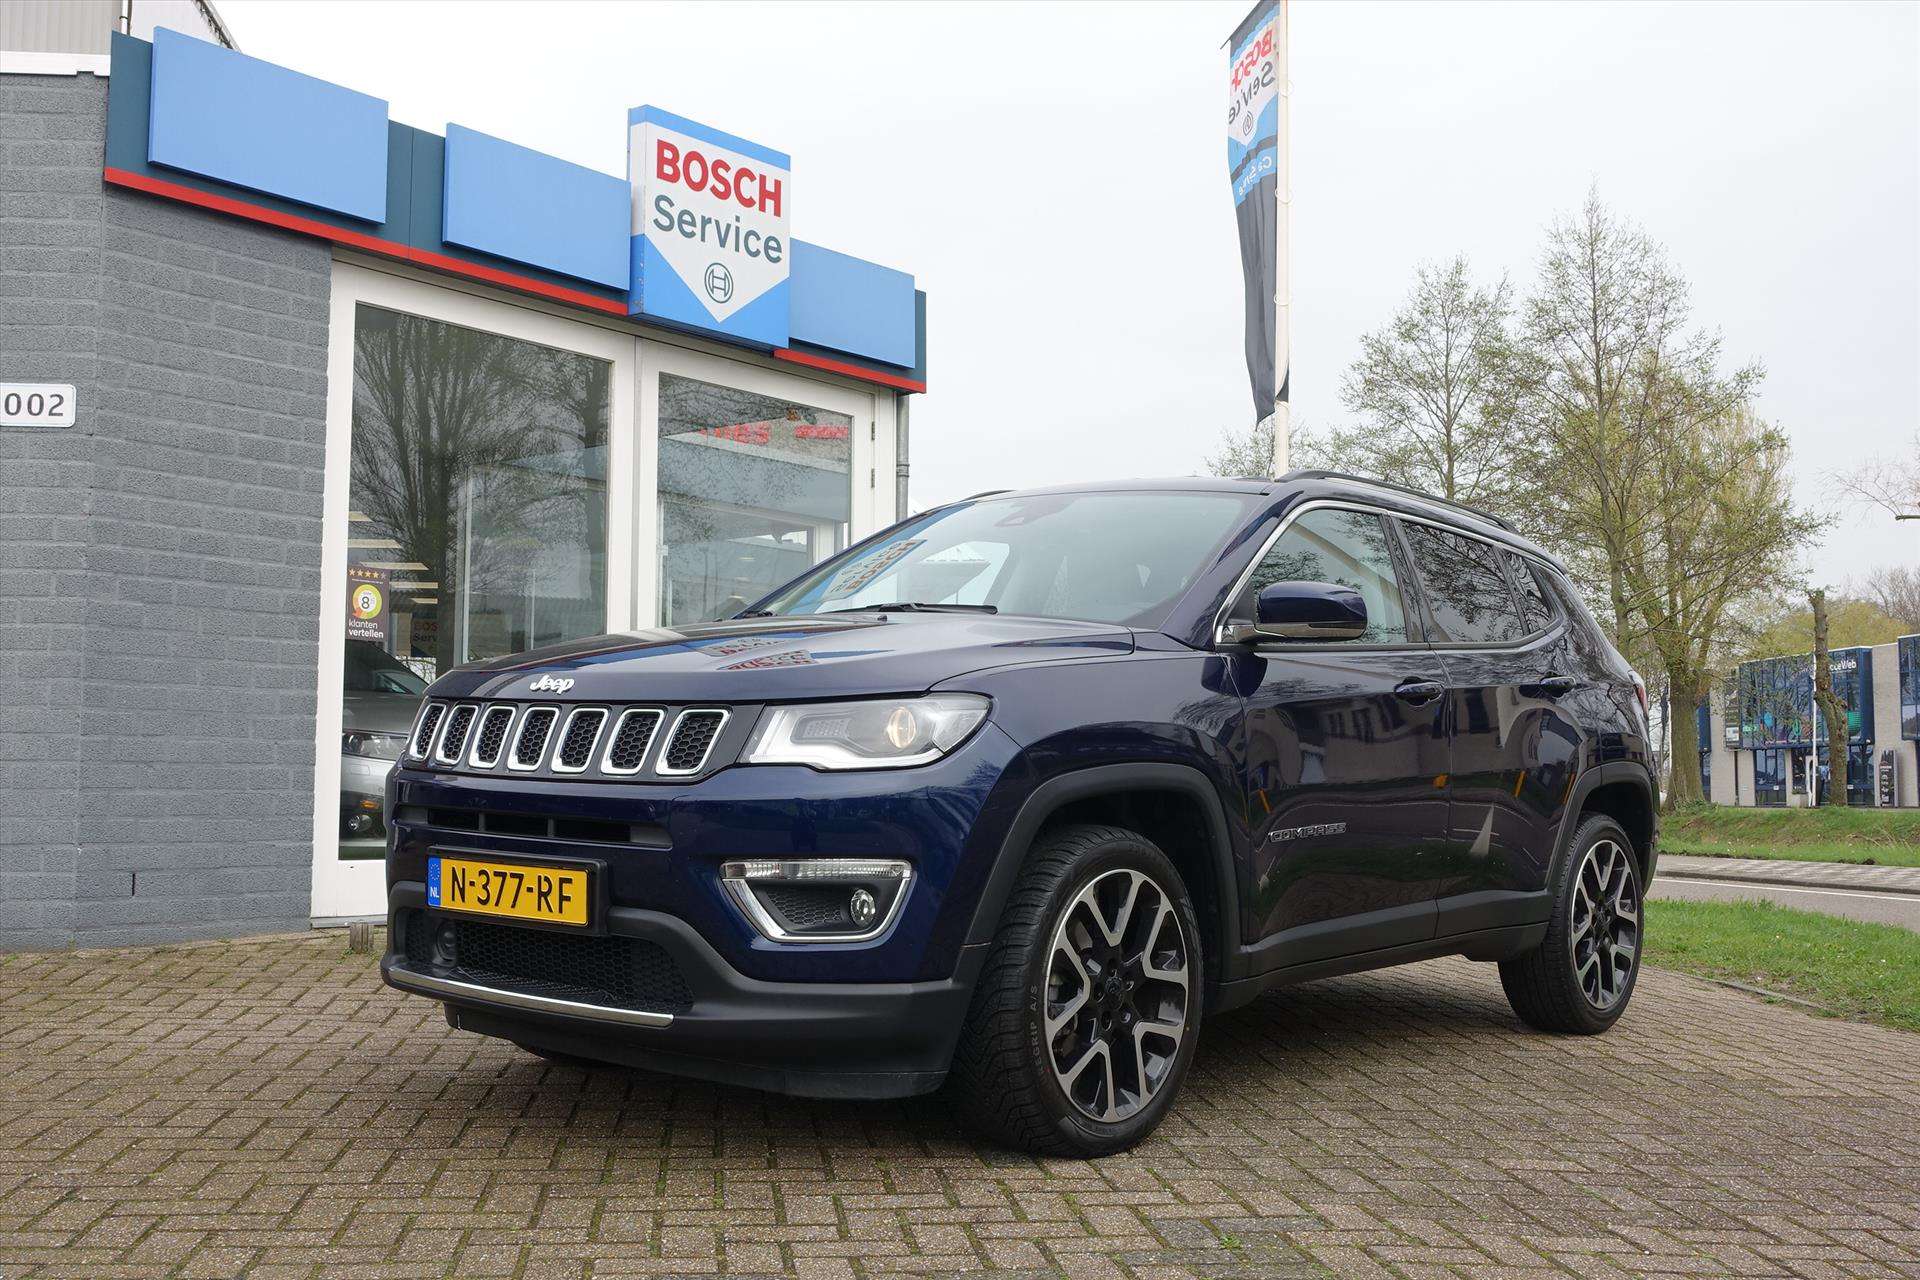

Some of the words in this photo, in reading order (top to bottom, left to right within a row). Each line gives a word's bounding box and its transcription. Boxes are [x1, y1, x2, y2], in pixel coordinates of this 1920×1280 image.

[656, 138, 782, 218] BOSCH
[653, 194, 783, 264] Service
[4, 392, 65, 416] 002
[361, 596, 370, 609] 8
[348, 619, 378, 629] klanten
[348, 628, 384, 638] vertellen
[529, 674, 575, 694] Jeep
[1268, 822, 1347, 843] COMPASS
[429, 886, 440, 899] NL
[451, 866, 573, 914] N-377-RF
